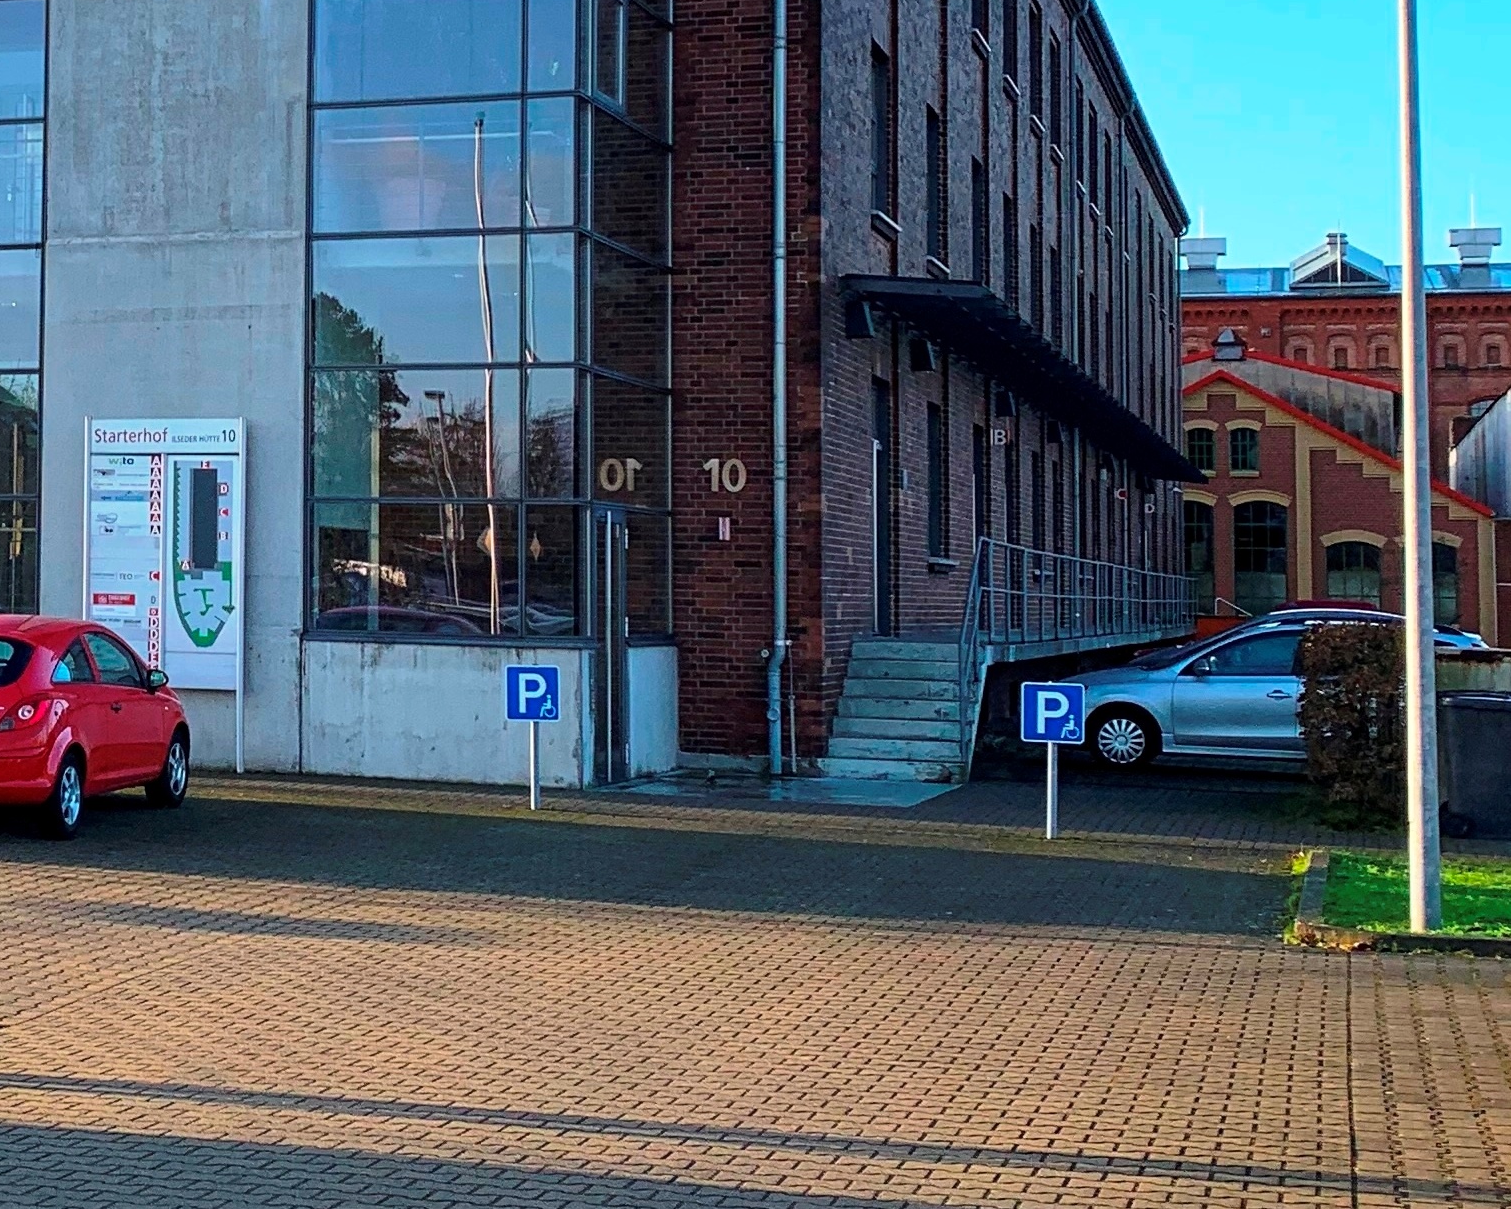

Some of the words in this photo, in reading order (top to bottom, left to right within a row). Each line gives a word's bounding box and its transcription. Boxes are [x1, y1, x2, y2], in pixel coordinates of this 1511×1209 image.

[94, 427, 168, 443] Starterhof
[222, 429, 236, 442] 10
[151, 455, 160, 466] A
[702, 458, 747, 493] 10
[220, 484, 228, 494] D
[181, 560, 190, 570] A
[150, 571, 159, 580] C
[150, 618, 158, 627] D
[150, 629, 158, 639] D
[150, 640, 158, 651] D
[518, 673, 547, 714] P
[1037, 691, 1069, 734] P
